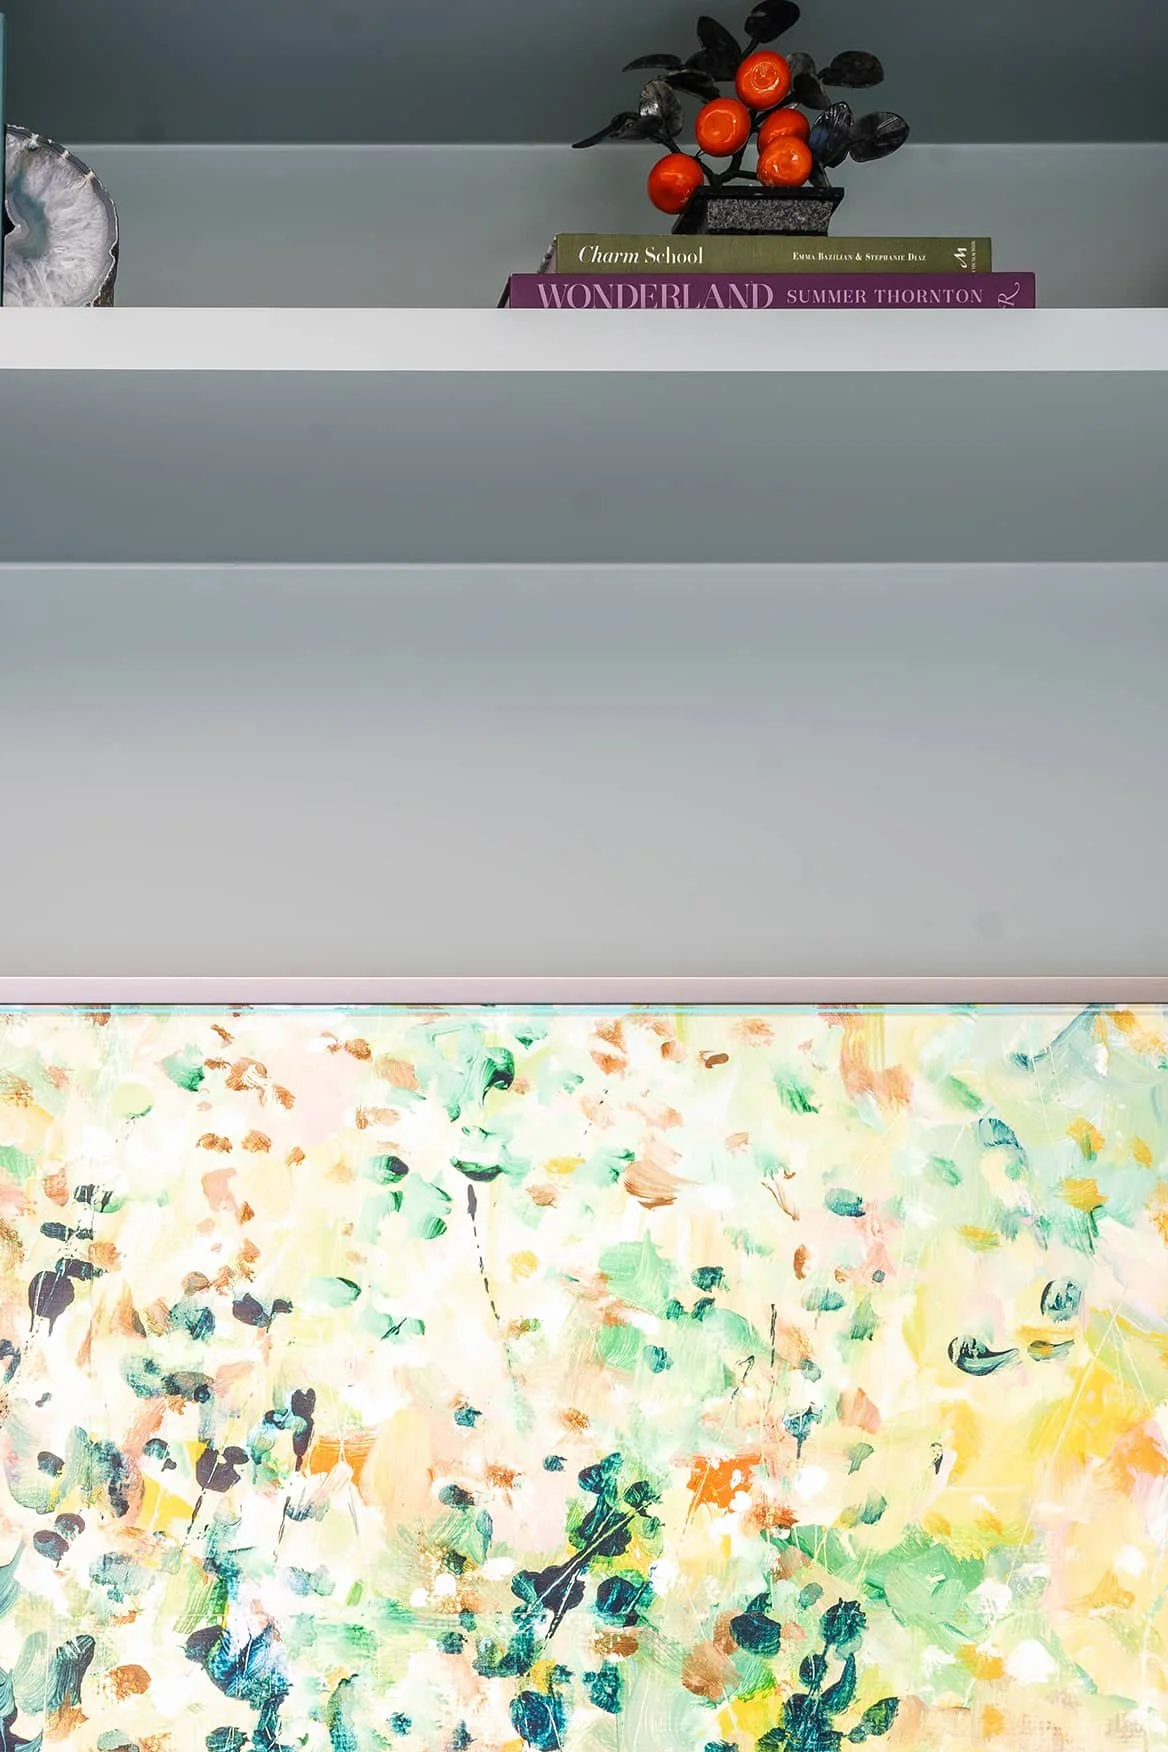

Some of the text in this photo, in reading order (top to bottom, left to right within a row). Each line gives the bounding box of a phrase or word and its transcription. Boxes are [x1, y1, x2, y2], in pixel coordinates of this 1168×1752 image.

[578, 245, 704, 265] Charm School
[792, 251, 816, 261] EMMA
[855, 252, 863, 261] &
[536, 283, 983, 309] WONDERLAND SUMMER THORNTON
